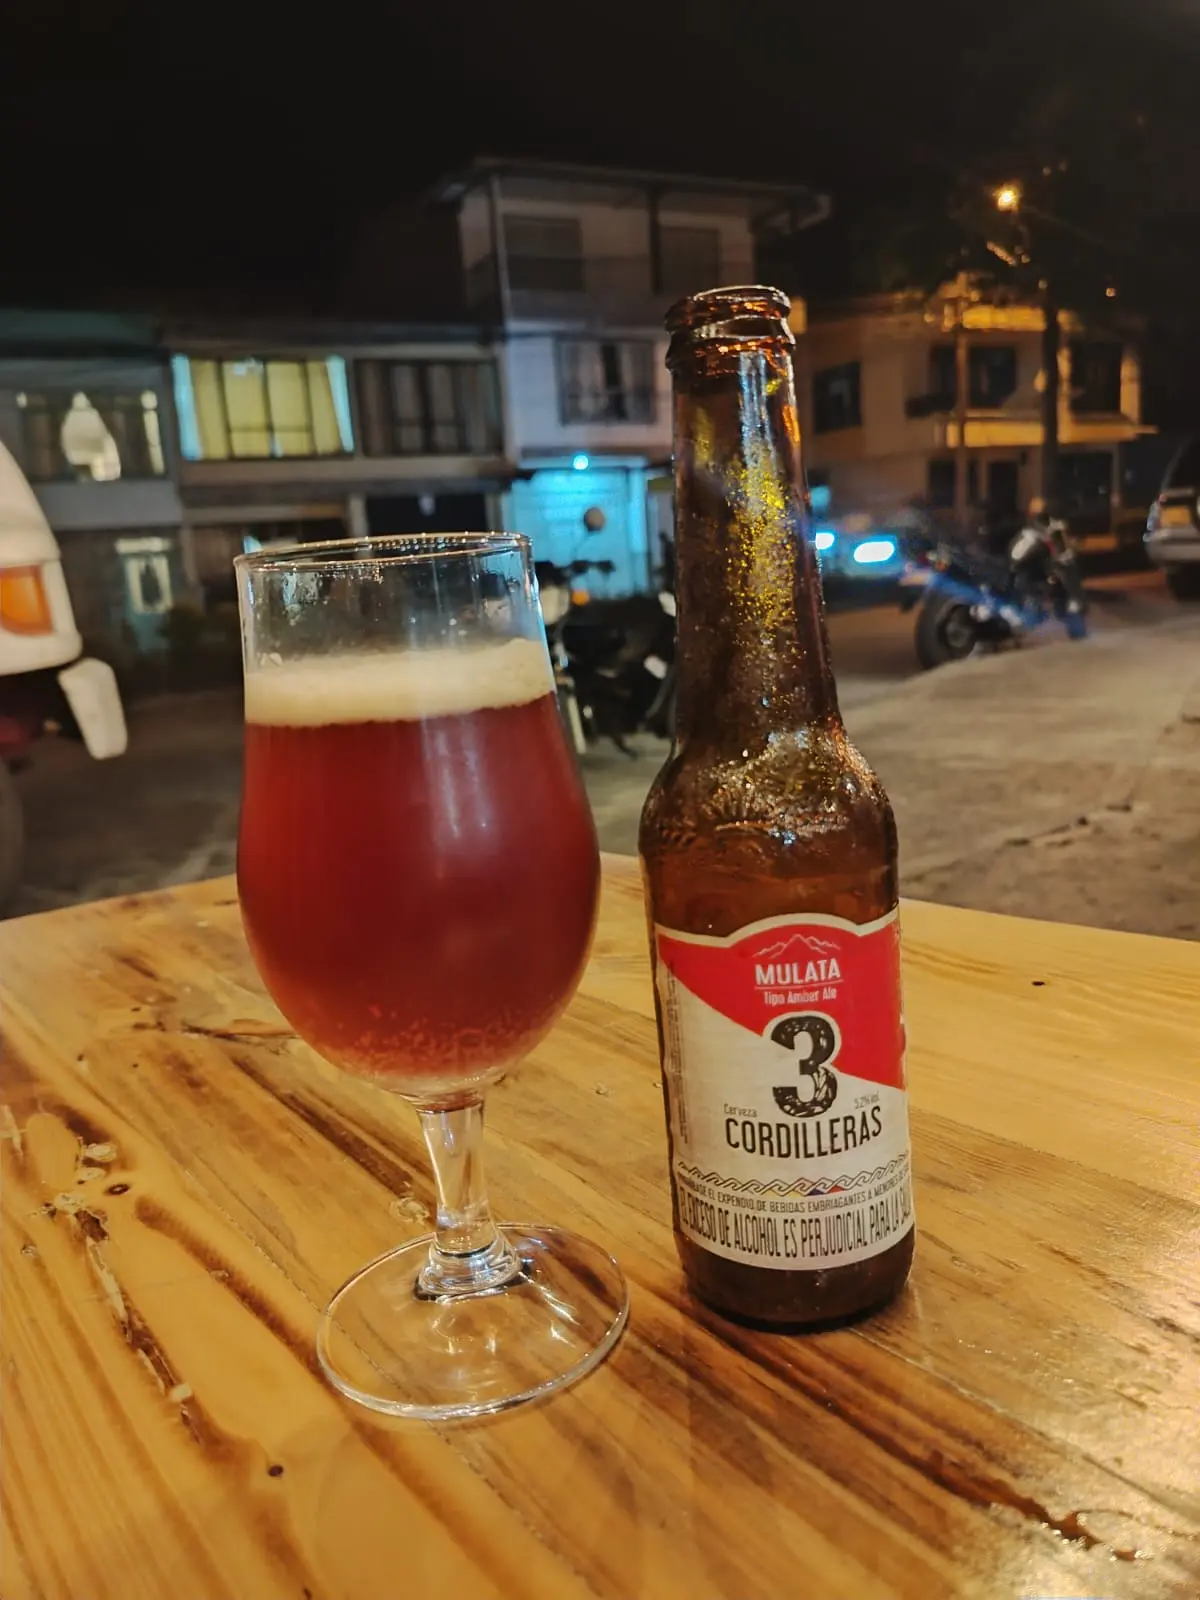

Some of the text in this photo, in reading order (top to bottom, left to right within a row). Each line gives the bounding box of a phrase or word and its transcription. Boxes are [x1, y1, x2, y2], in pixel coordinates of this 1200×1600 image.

[755, 958, 841, 985] MULATA
[764, 986, 837, 1007] Tipo Amber Ale
[770, 1015, 839, 1118] 3
[723, 1103, 758, 1118] Cerveza
[725, 1105, 882, 1159] CORDILLERAS
[717, 1191, 755, 1211] EXPENDIO
[756, 1199, 766, 1212] DE
[769, 1200, 806, 1214] BEBIDAS
[807, 1191, 866, 1213] EMBRIAGANTES
[867, 1189, 873, 1201] A
[718, 1207, 732, 1249] DE
[734, 1211, 781, 1257] ALCOHOL
[783, 1218, 798, 1258] ES
[800, 1208, 868, 1258] PERJUDICIAL
[869, 1200, 891, 1244] PARA
